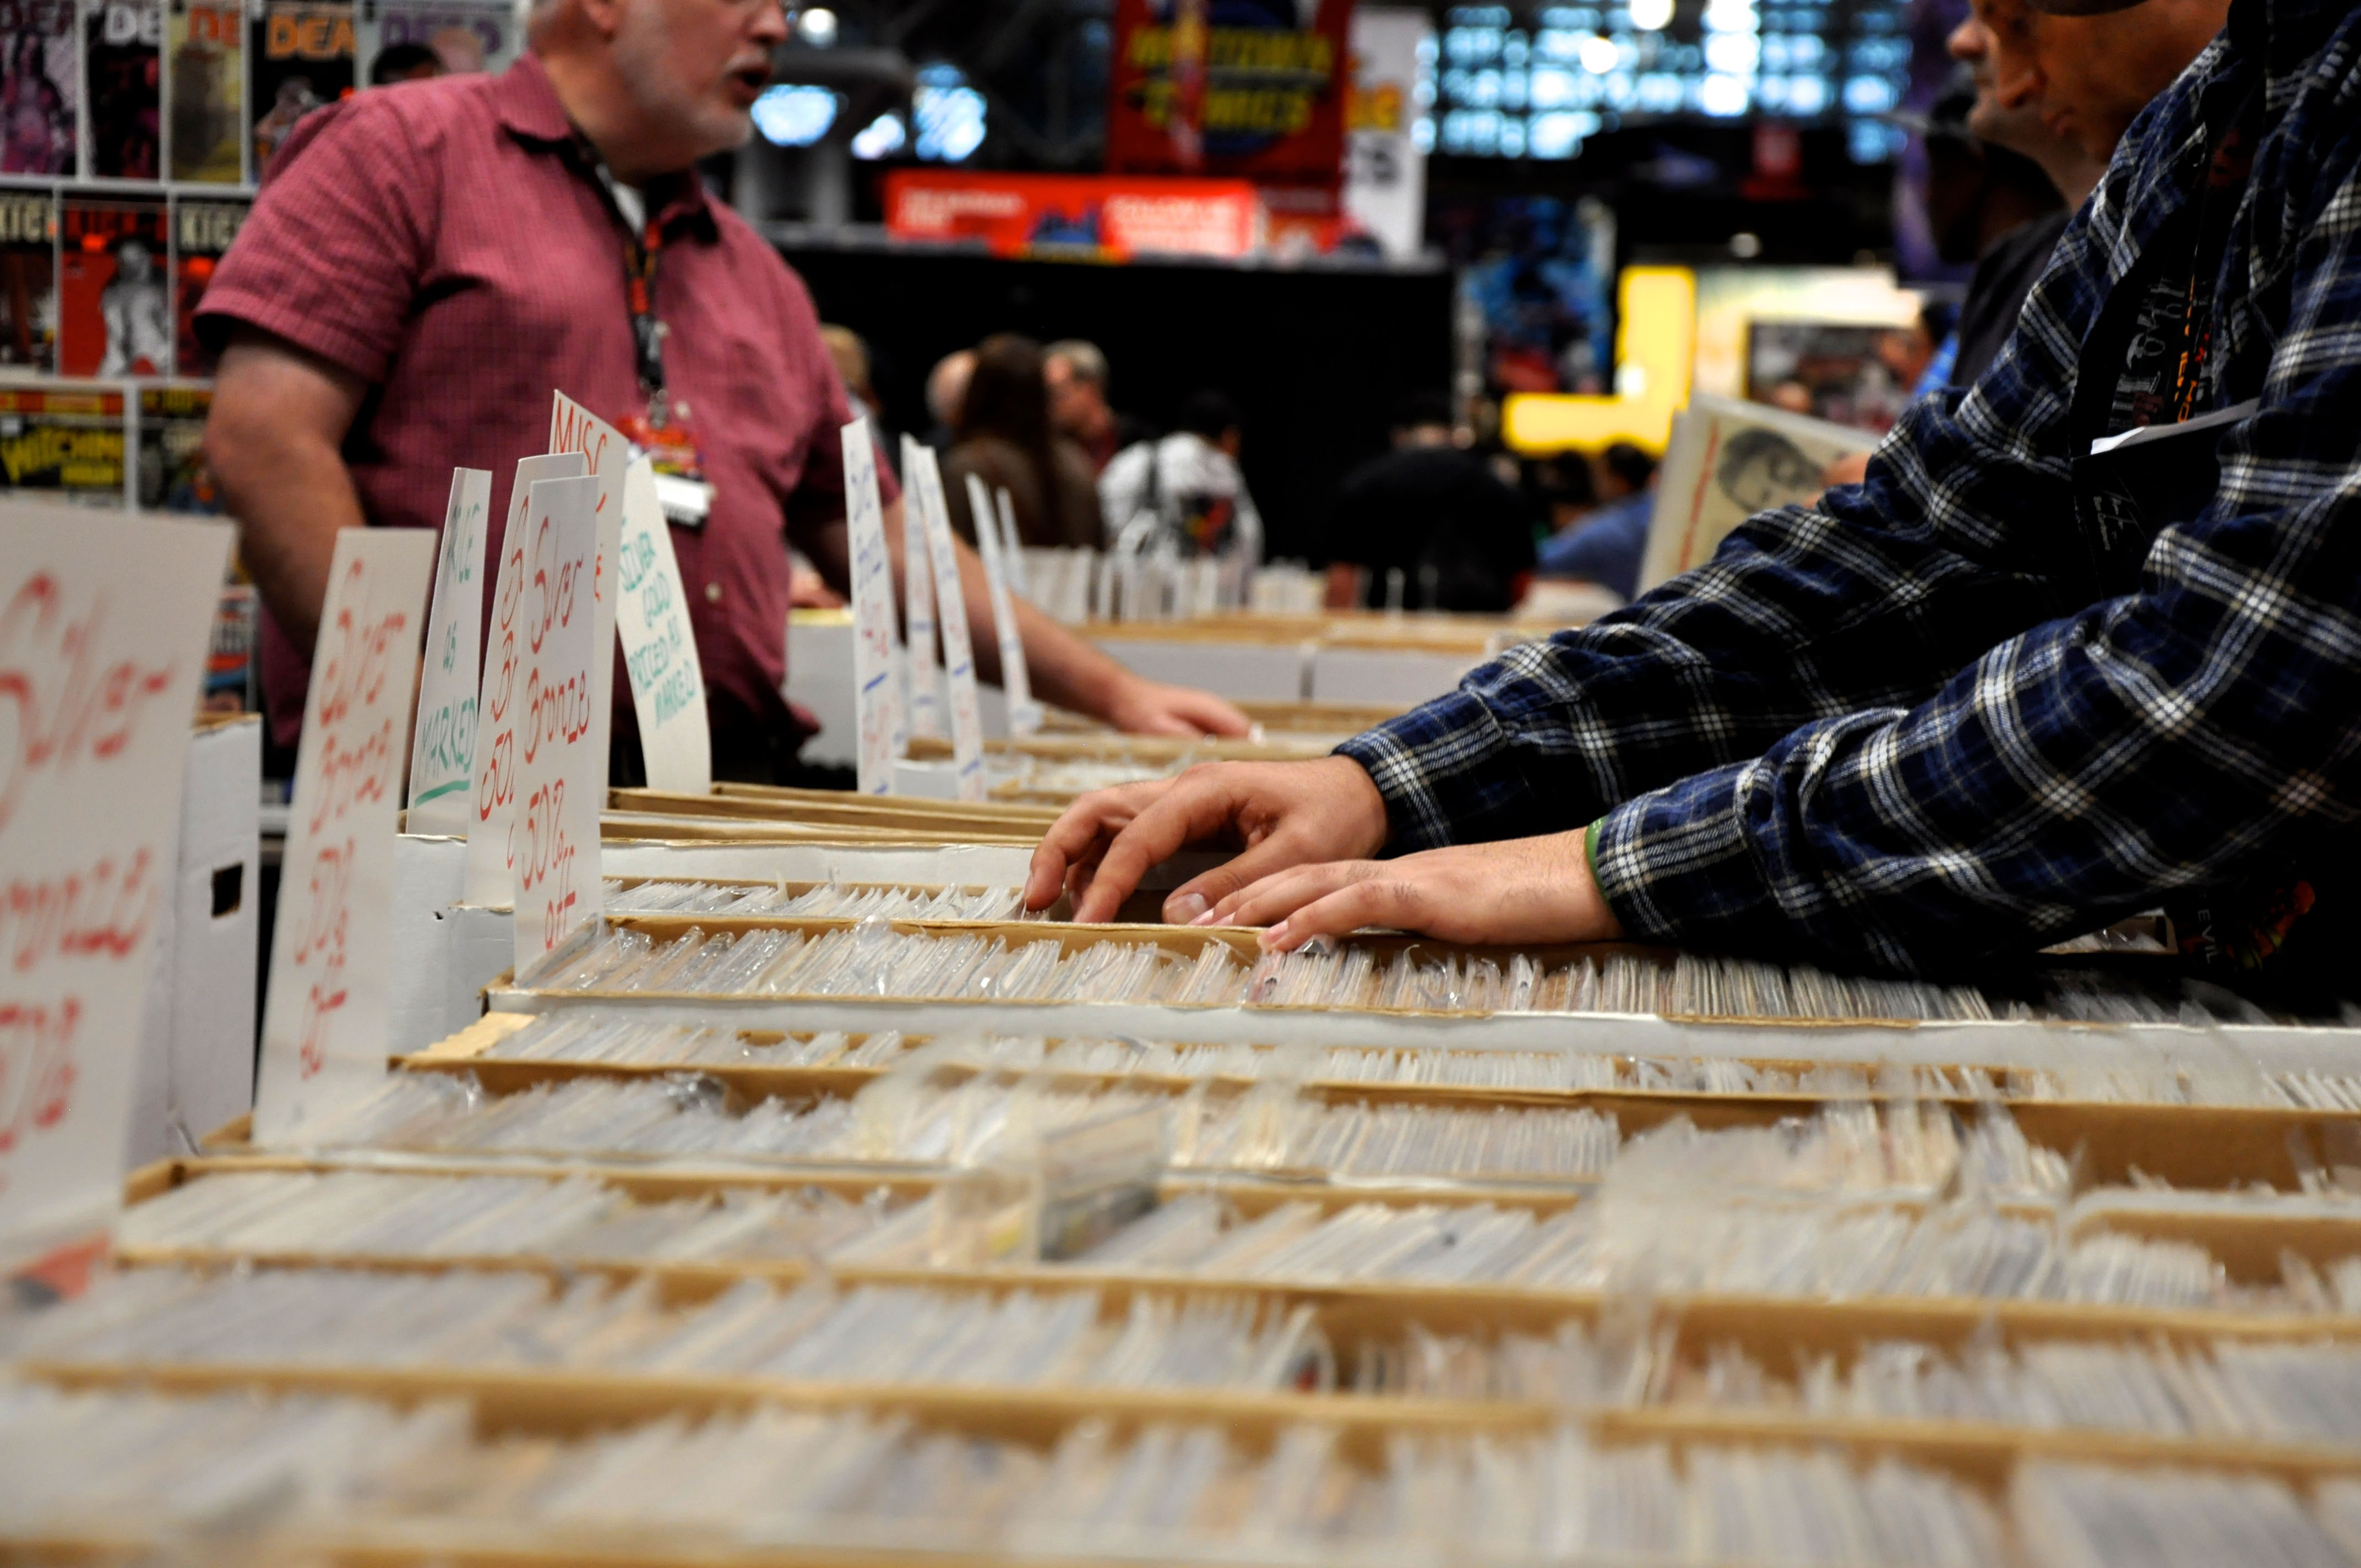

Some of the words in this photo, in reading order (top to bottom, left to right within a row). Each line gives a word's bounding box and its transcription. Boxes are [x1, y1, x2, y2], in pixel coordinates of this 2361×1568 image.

[416, 695, 476, 789] MARKED
[524, 667, 590, 764] Bronze
[522, 778, 564, 891] 50%
